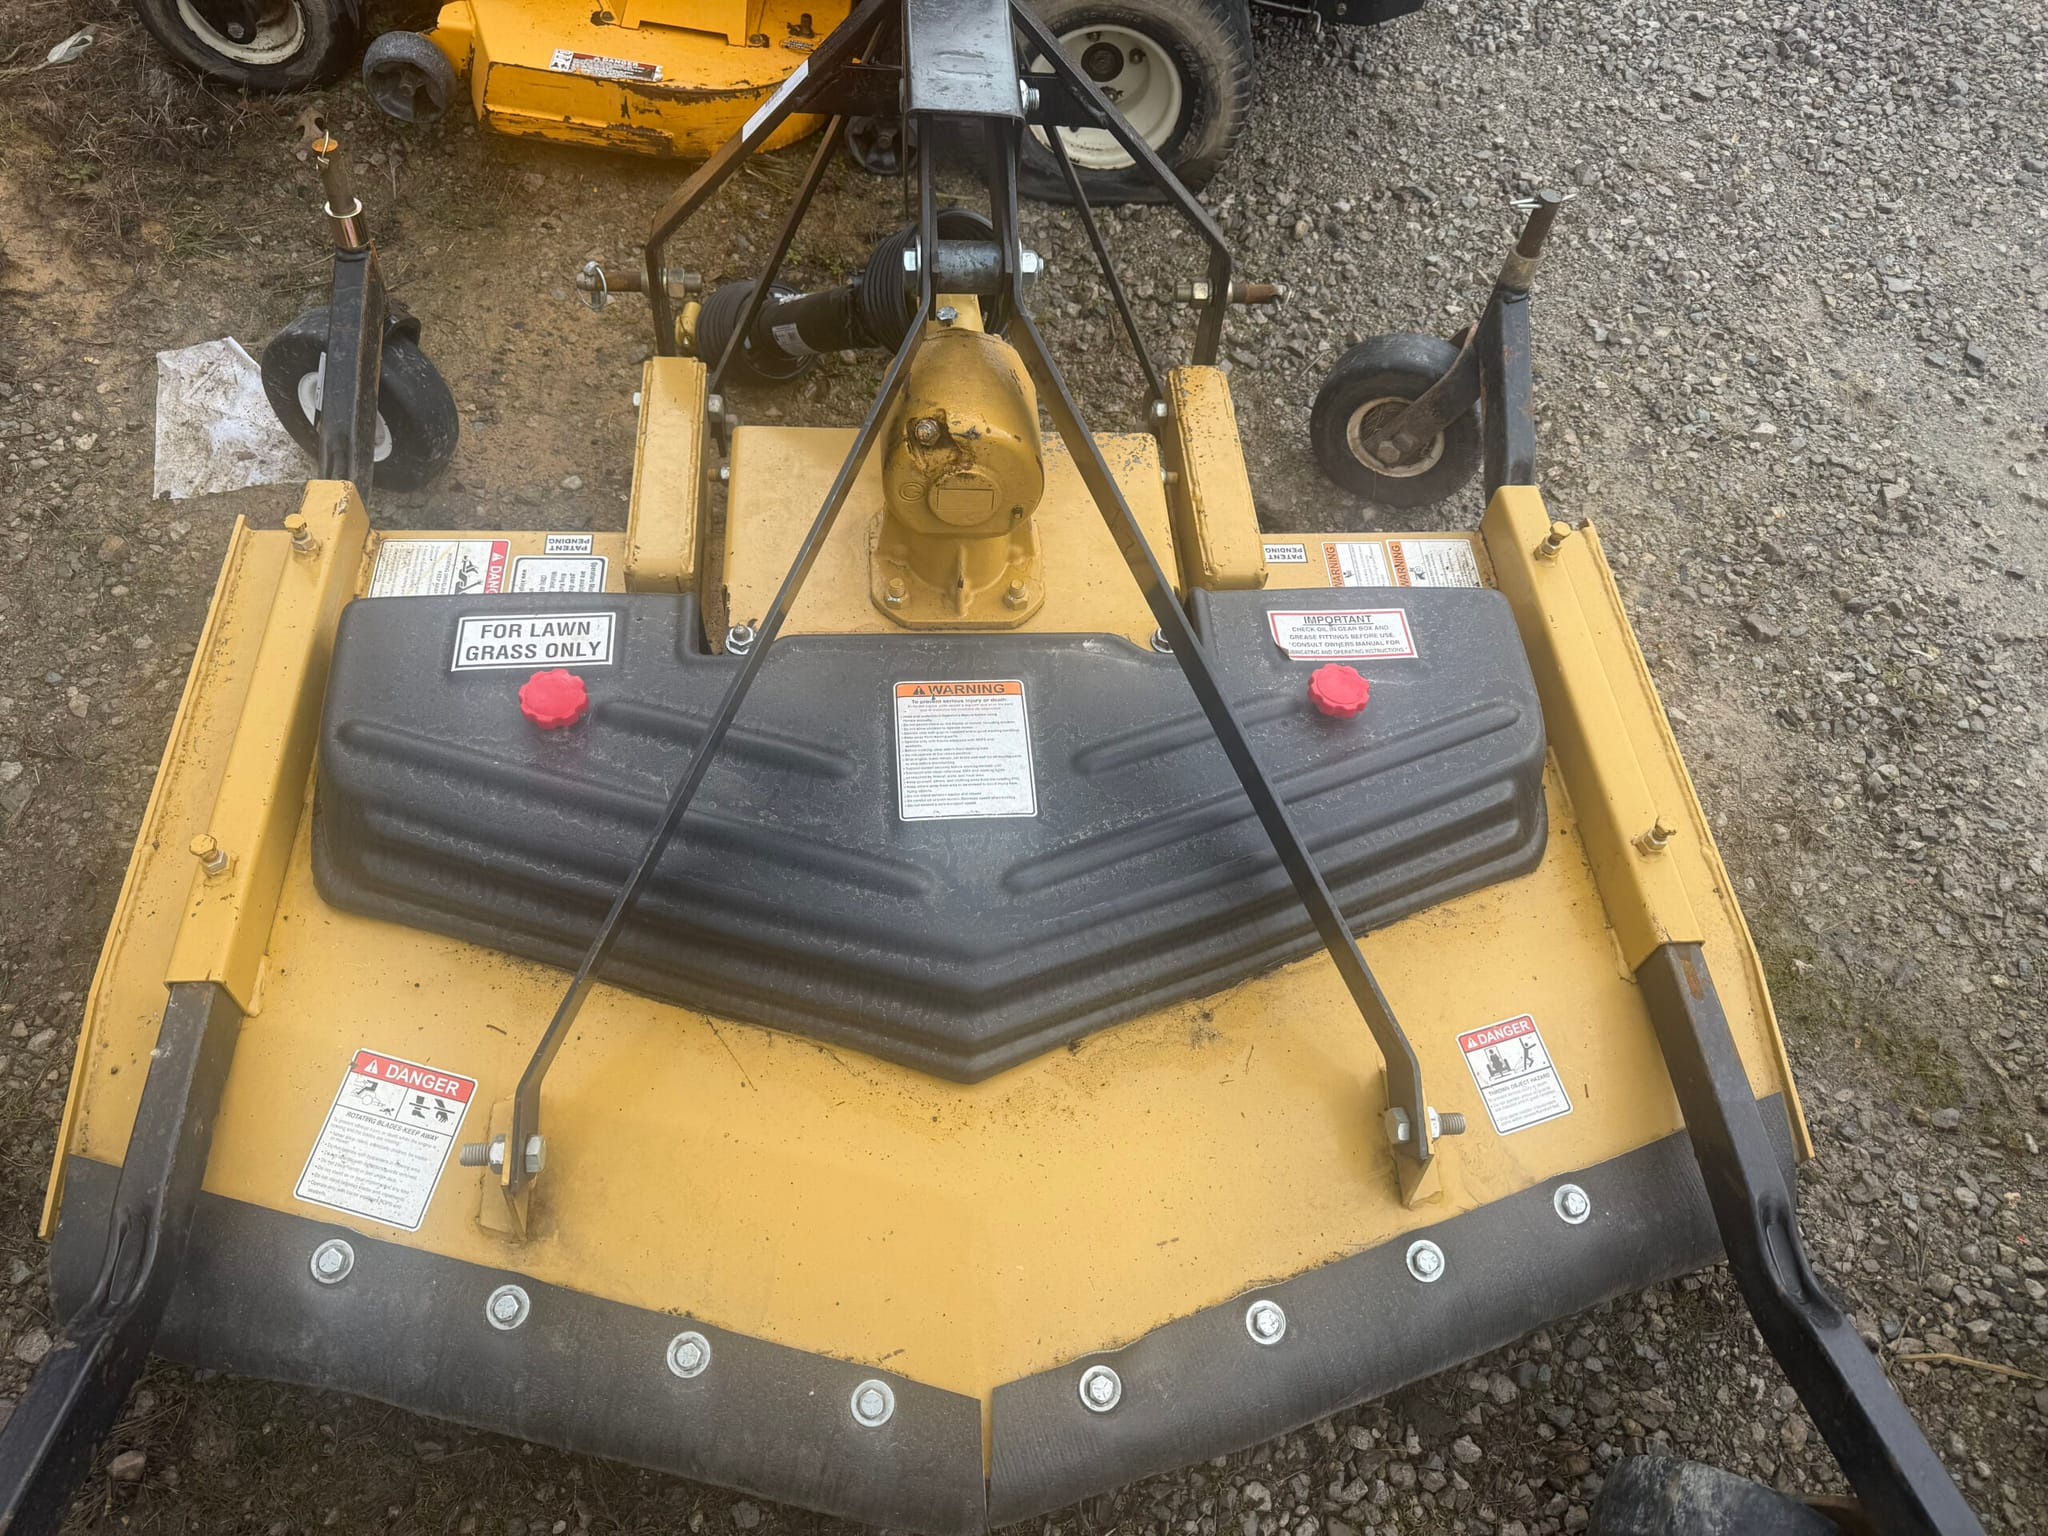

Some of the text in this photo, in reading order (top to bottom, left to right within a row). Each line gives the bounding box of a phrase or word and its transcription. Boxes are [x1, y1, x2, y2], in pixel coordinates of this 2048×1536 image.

[481, 621, 591, 639] FOR LAWN
[1303, 615, 1372, 624] IMPORTANT
[466, 641, 602, 662] GRASS ONLY
[928, 684, 1005, 695] WARNING
[1477, 1020, 1530, 1045] DANGER
[385, 1063, 460, 1096] DANGER
[346, 1111, 376, 1125] ROTATING
[420, 1132, 440, 1142] AWAY
